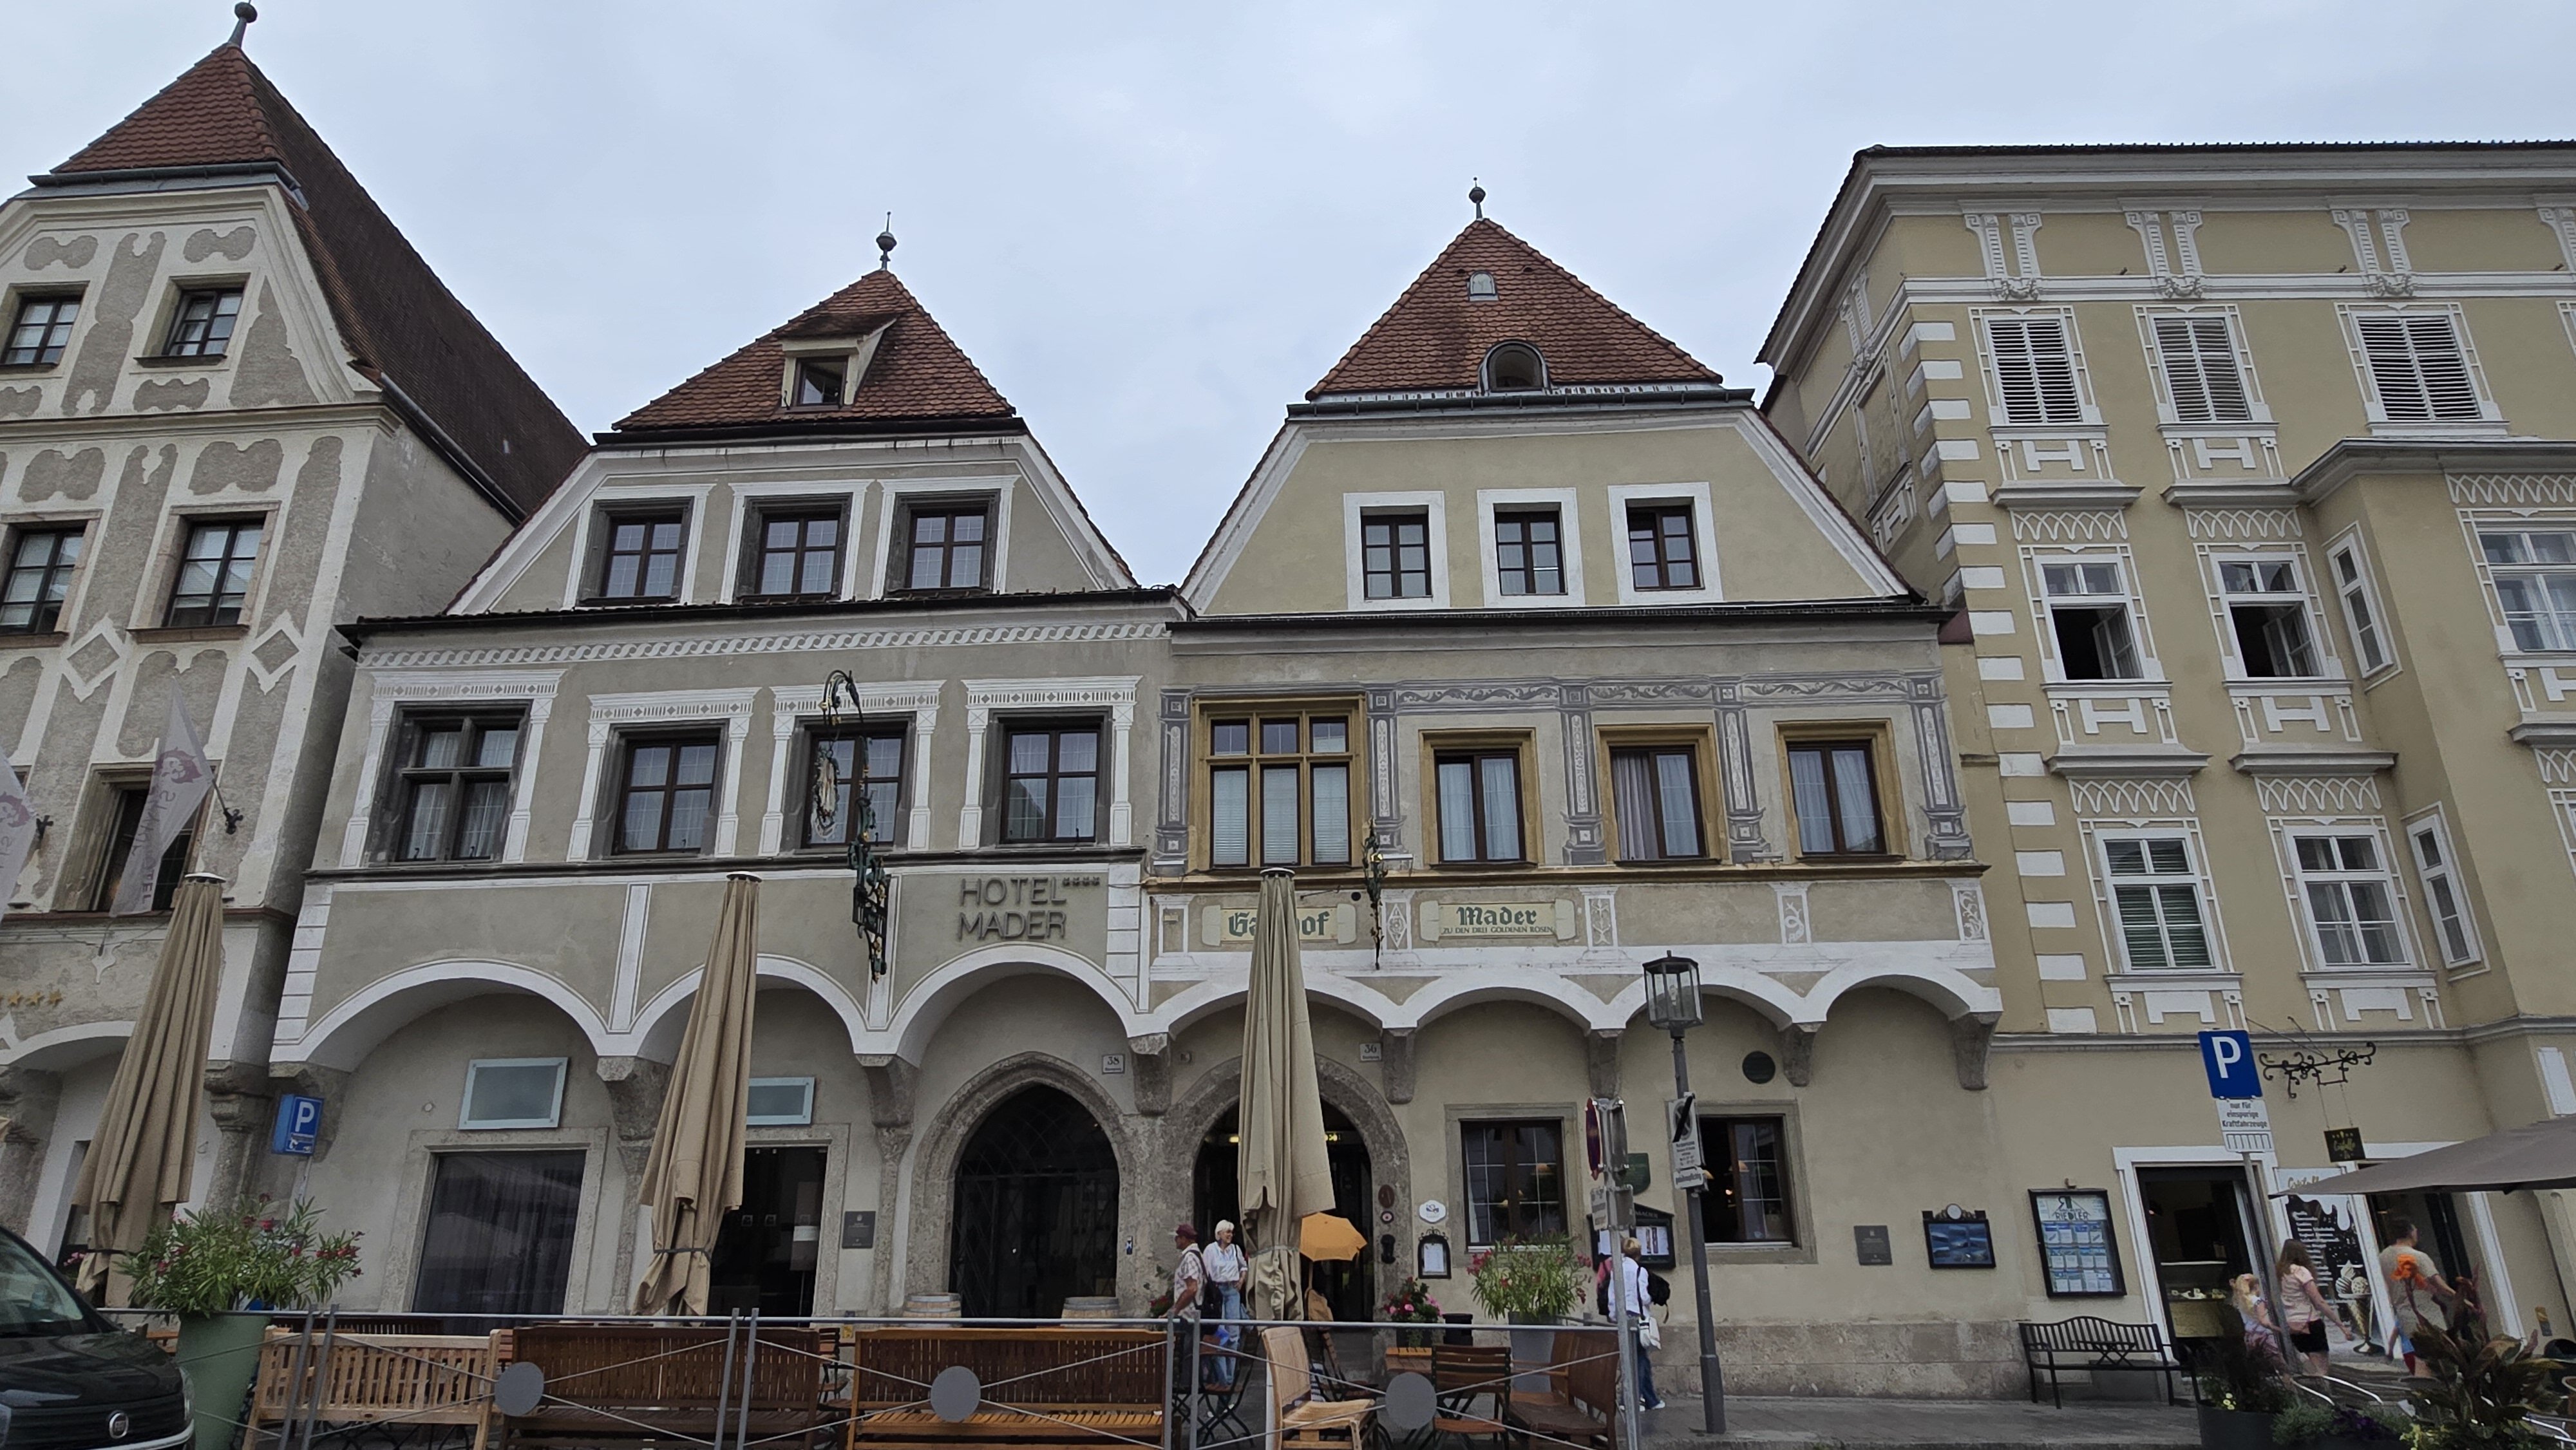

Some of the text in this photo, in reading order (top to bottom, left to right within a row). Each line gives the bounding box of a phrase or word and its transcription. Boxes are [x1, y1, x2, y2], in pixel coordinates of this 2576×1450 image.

[960, 876, 1067, 906] HOTEL
[958, 910, 1067, 941] MADER
[1228, 911, 1330, 937] Gaof
[1456, 906, 1537, 926] Mader
[1364, 1044, 1377, 1053] 36
[2211, 1036, 2241, 1078] P
[1107, 1056, 1119, 1065] 38
[294, 1100, 315, 1132] P
[2226, 1109, 2259, 1119] einspurige
[2222, 1120, 2268, 1129] Kraftfahrzeuge
[2055, 1211, 2089, 1221] RIEDLER
